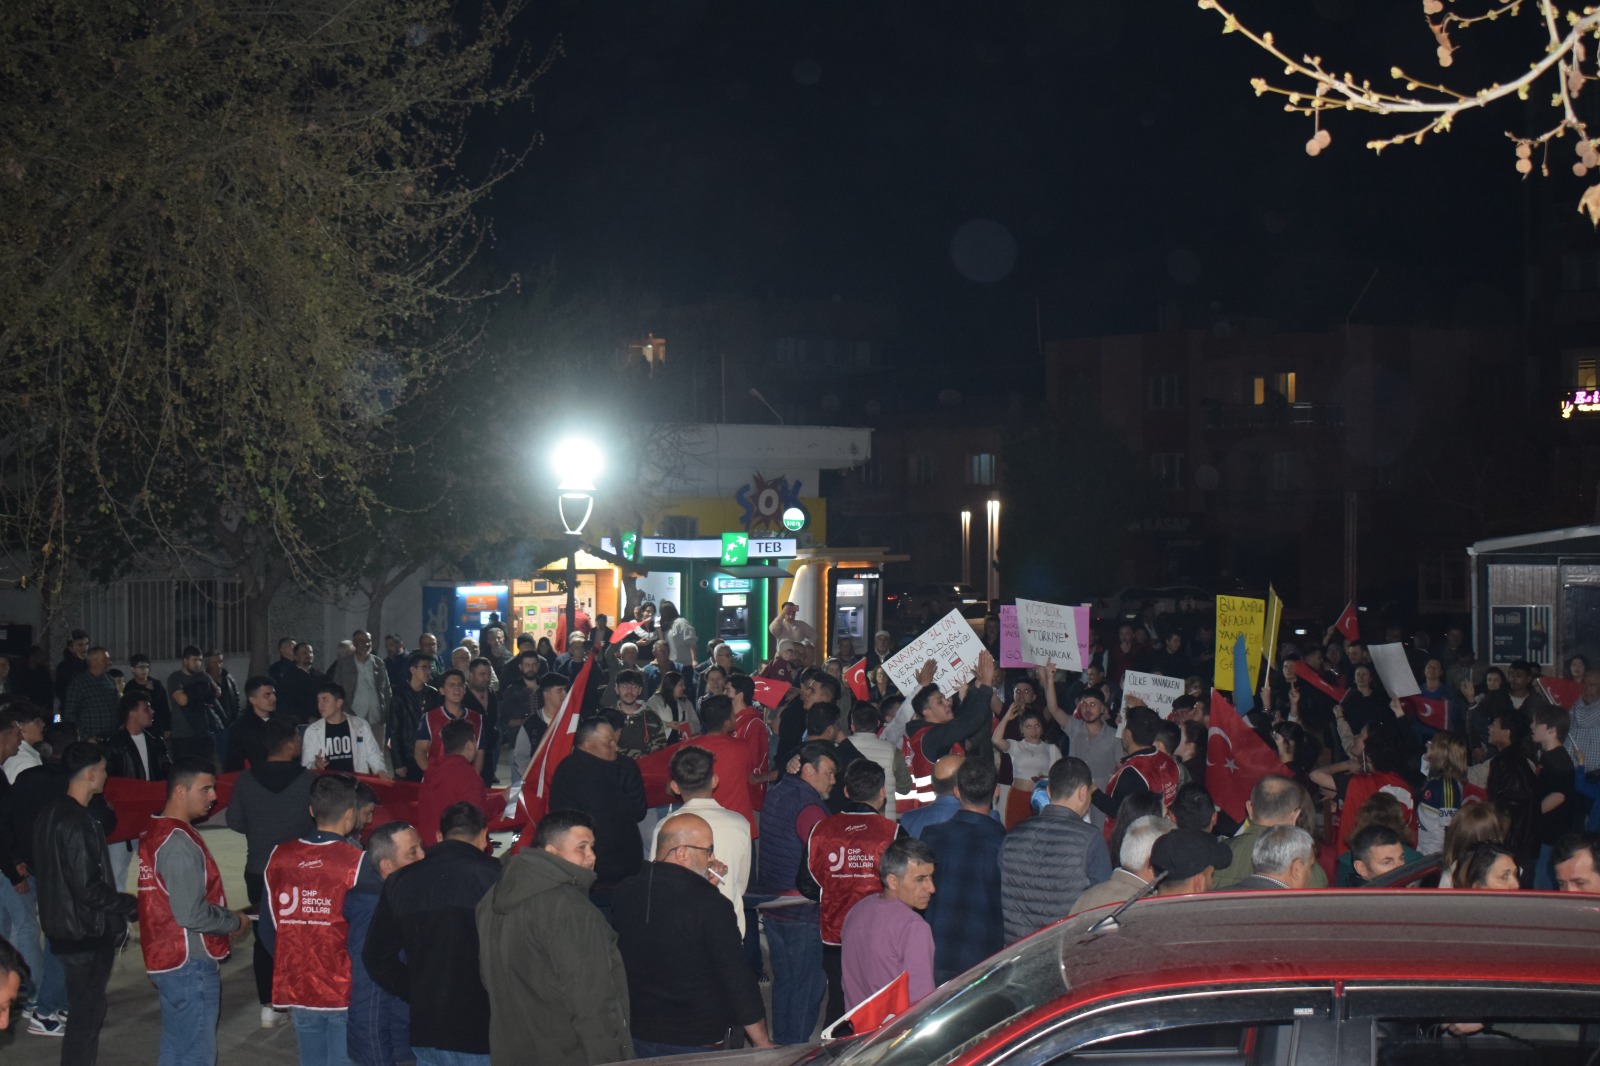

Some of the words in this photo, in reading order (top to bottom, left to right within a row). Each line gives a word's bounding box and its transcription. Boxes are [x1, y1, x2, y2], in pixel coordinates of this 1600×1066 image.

[655, 542, 676, 554] TEB
[756, 541, 782, 553] TEB
[1219, 597, 1236, 612] BU
[887, 639, 927, 671] ANAYASA
[1029, 644, 1074, 660] KAZANACAK
[1128, 673, 1147, 686] ÜLKE
[847, 854, 875, 862] GENÇLİK
[301, 889, 318, 897] CHP
[301, 897, 332, 906] GENÇLİK
[301, 906, 331, 914] KOLLARI
